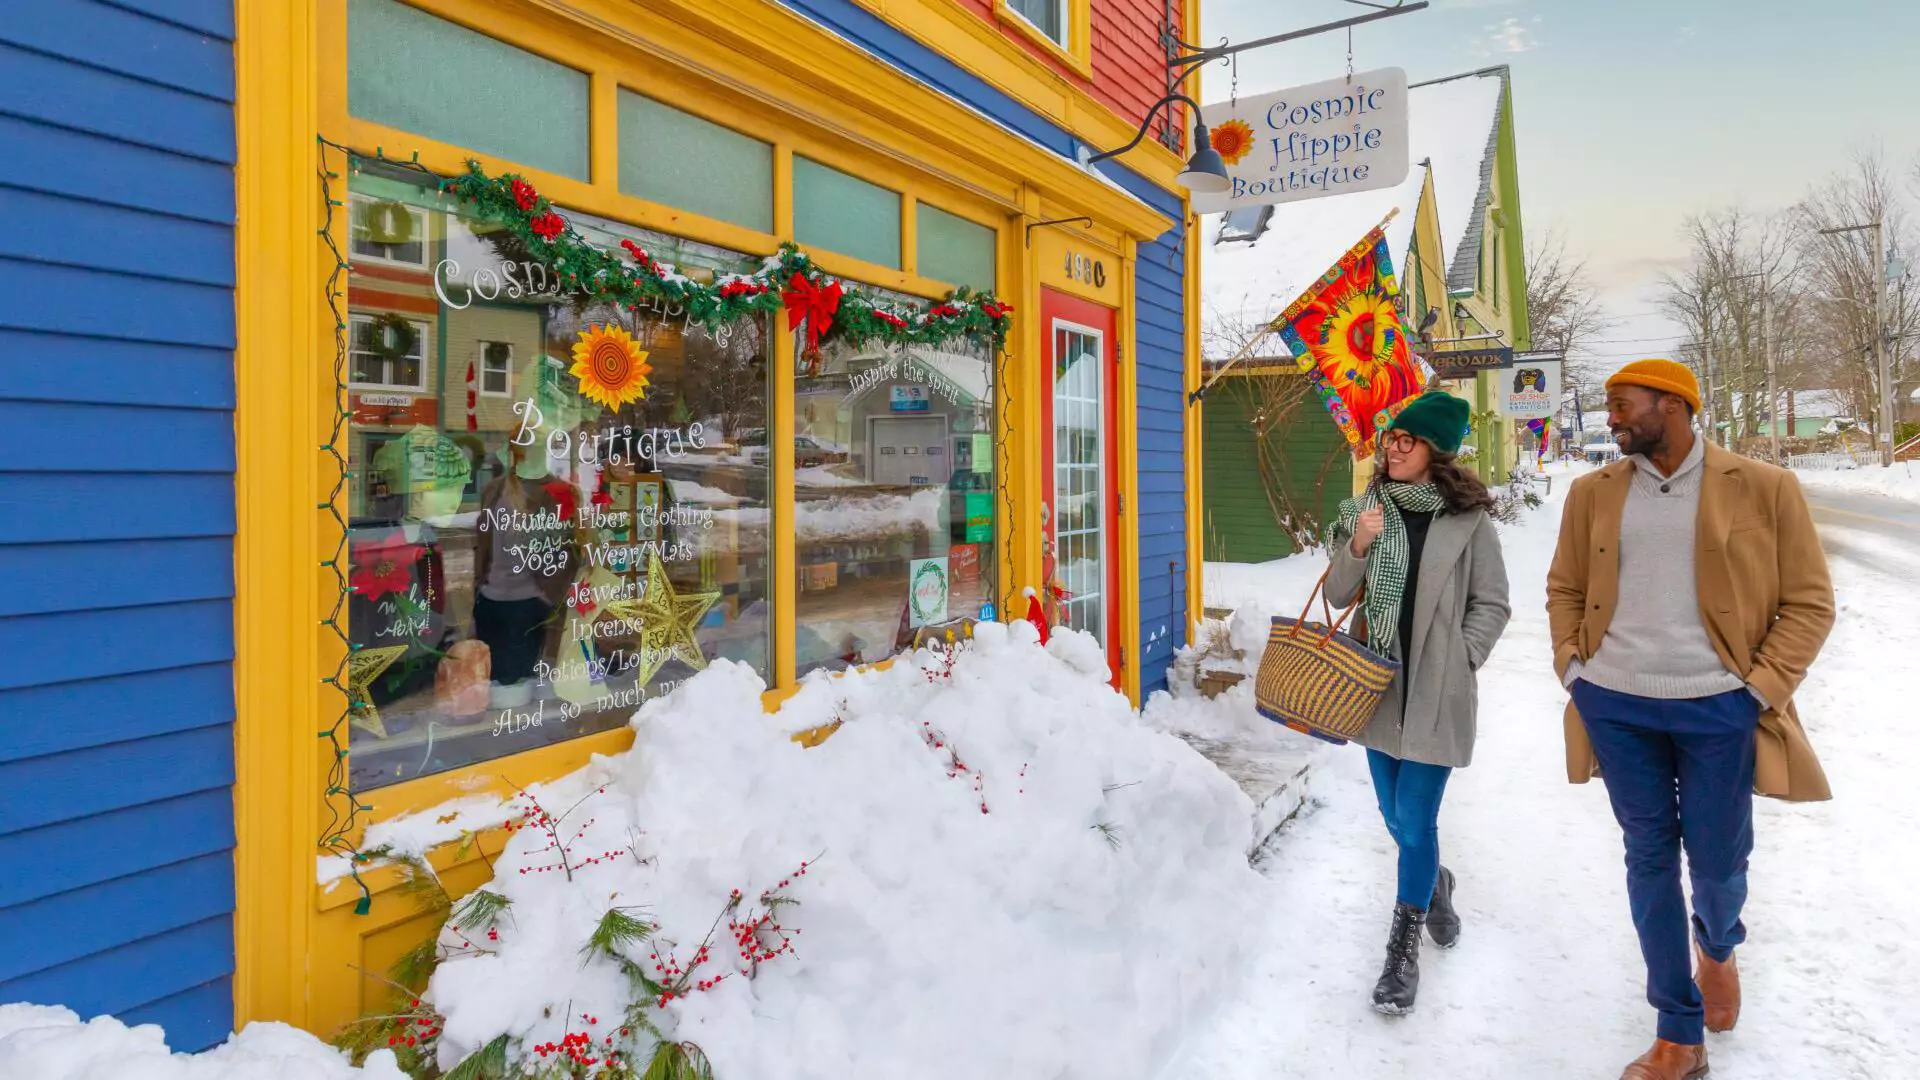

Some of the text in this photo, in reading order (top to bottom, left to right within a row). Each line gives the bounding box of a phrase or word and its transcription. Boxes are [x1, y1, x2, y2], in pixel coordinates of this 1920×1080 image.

[1267, 85, 1384, 130] Cosmic
[1269, 123, 1381, 171] Hippie
[1231, 164, 1368, 199] Boutique
[434, 258, 594, 310] Cosm
[848, 358, 959, 406] inspire the spirit
[511, 396, 705, 473] Boutique
[480, 503, 563, 532] Natural
[577, 504, 628, 530] Fiber
[640, 501, 714, 530] Clothing
[510, 541, 693, 577] Yoga Wear/Mats
[566, 575, 648, 608] Jewelry
[571, 617, 644, 642] Incense
[493, 679, 686, 737] And so much mo
